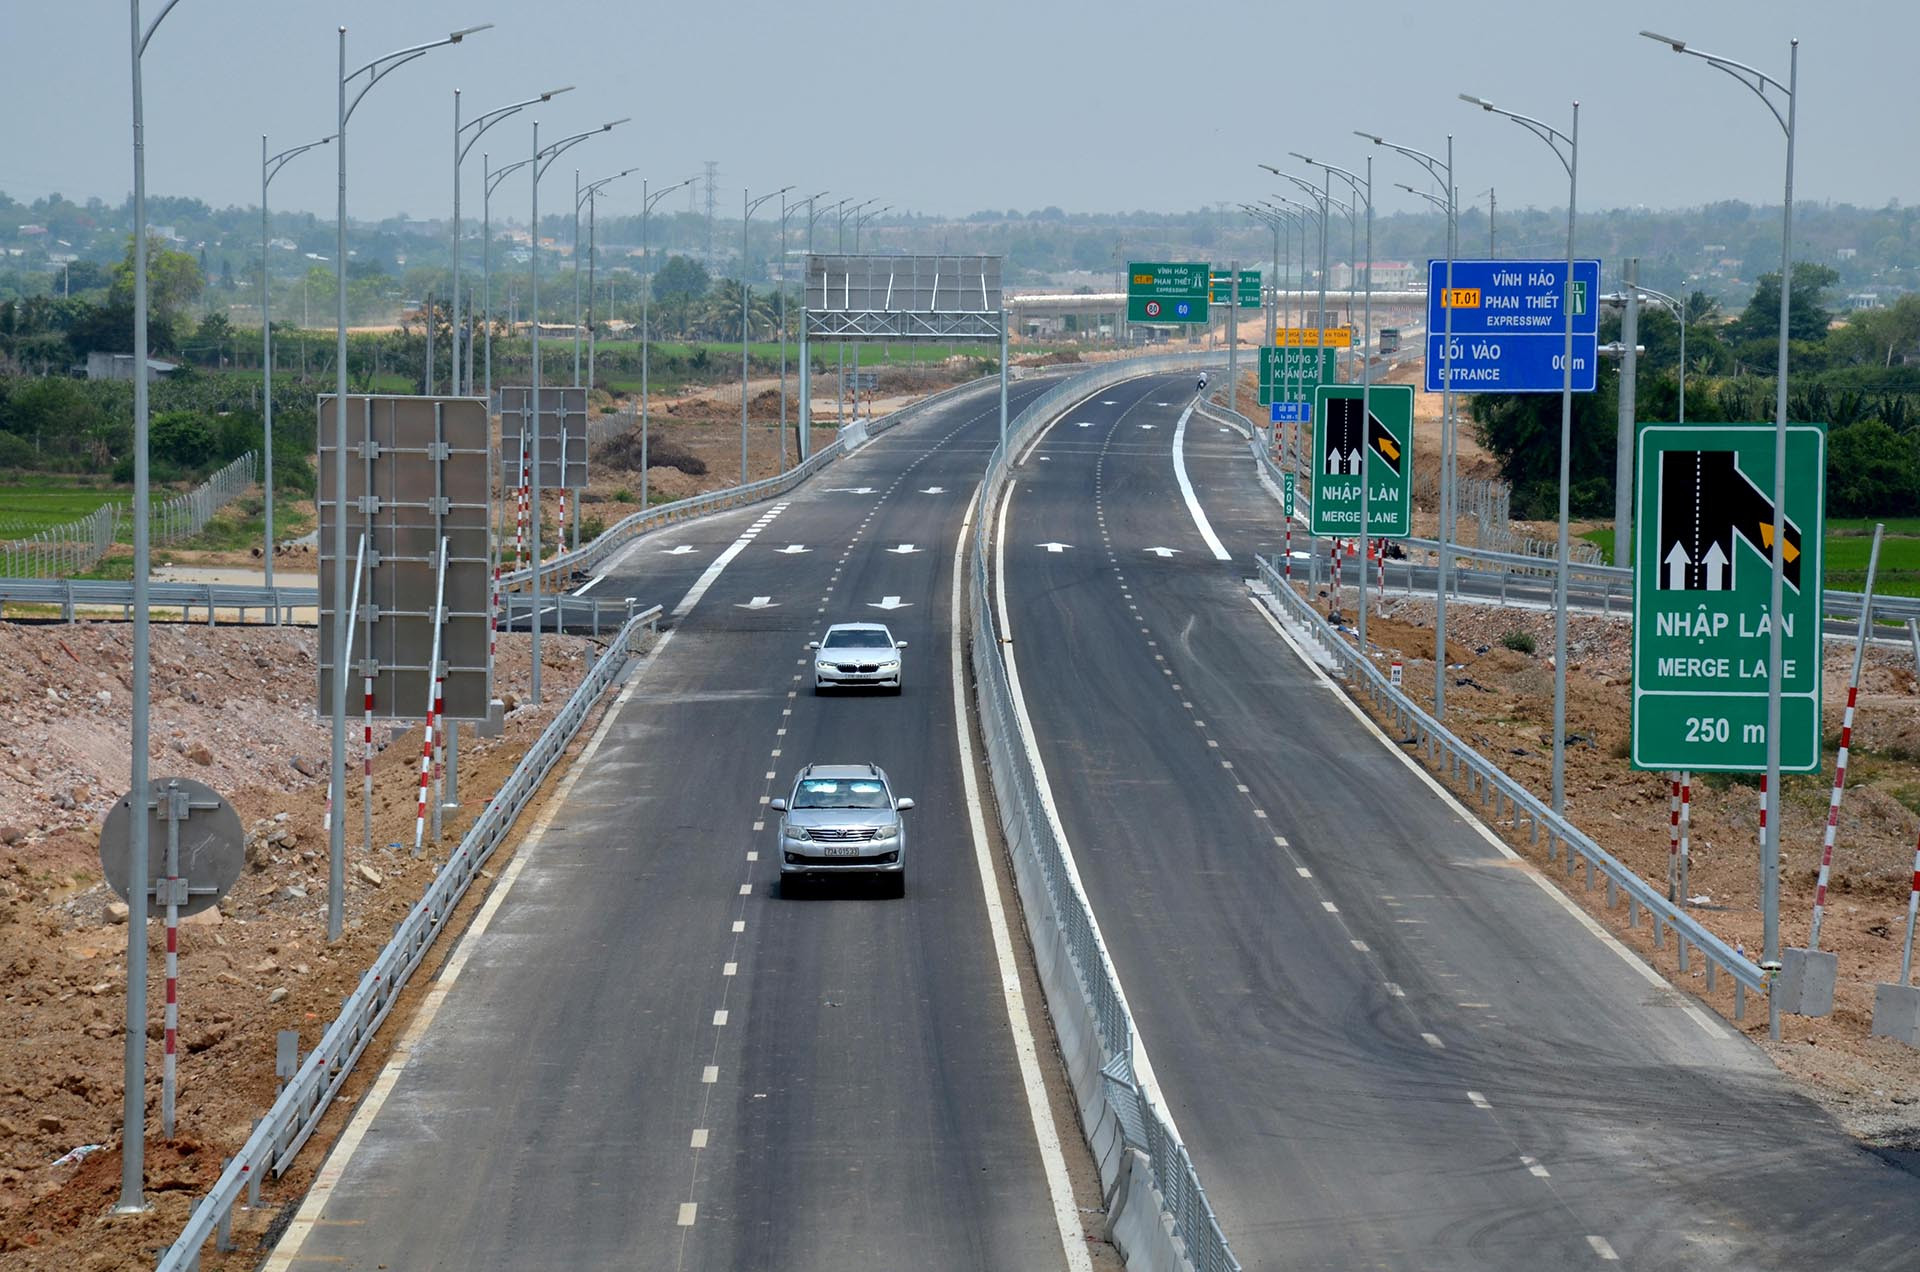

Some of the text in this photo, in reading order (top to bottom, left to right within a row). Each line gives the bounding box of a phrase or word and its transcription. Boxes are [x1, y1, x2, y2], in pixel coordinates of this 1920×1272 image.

[1492, 269, 1555, 286] VĨNH HẢO
[1148, 304, 1158, 313] 80
[1485, 290, 1559, 309] PHAN THIẾT
[1178, 304, 1188, 314] 60
[1487, 316, 1552, 326] EXPRESSWAY
[1472, 339, 1501, 360] VÀO
[1573, 357, 1585, 370] m
[1322, 482, 1399, 504] NHẬP LÀN
[1321, 511, 1398, 524] MERGE LANE
[1656, 604, 1794, 645] NHẬP LÀN
[1657, 657, 1797, 679] MERGE LAE
[1685, 717, 1766, 743] 250 m
